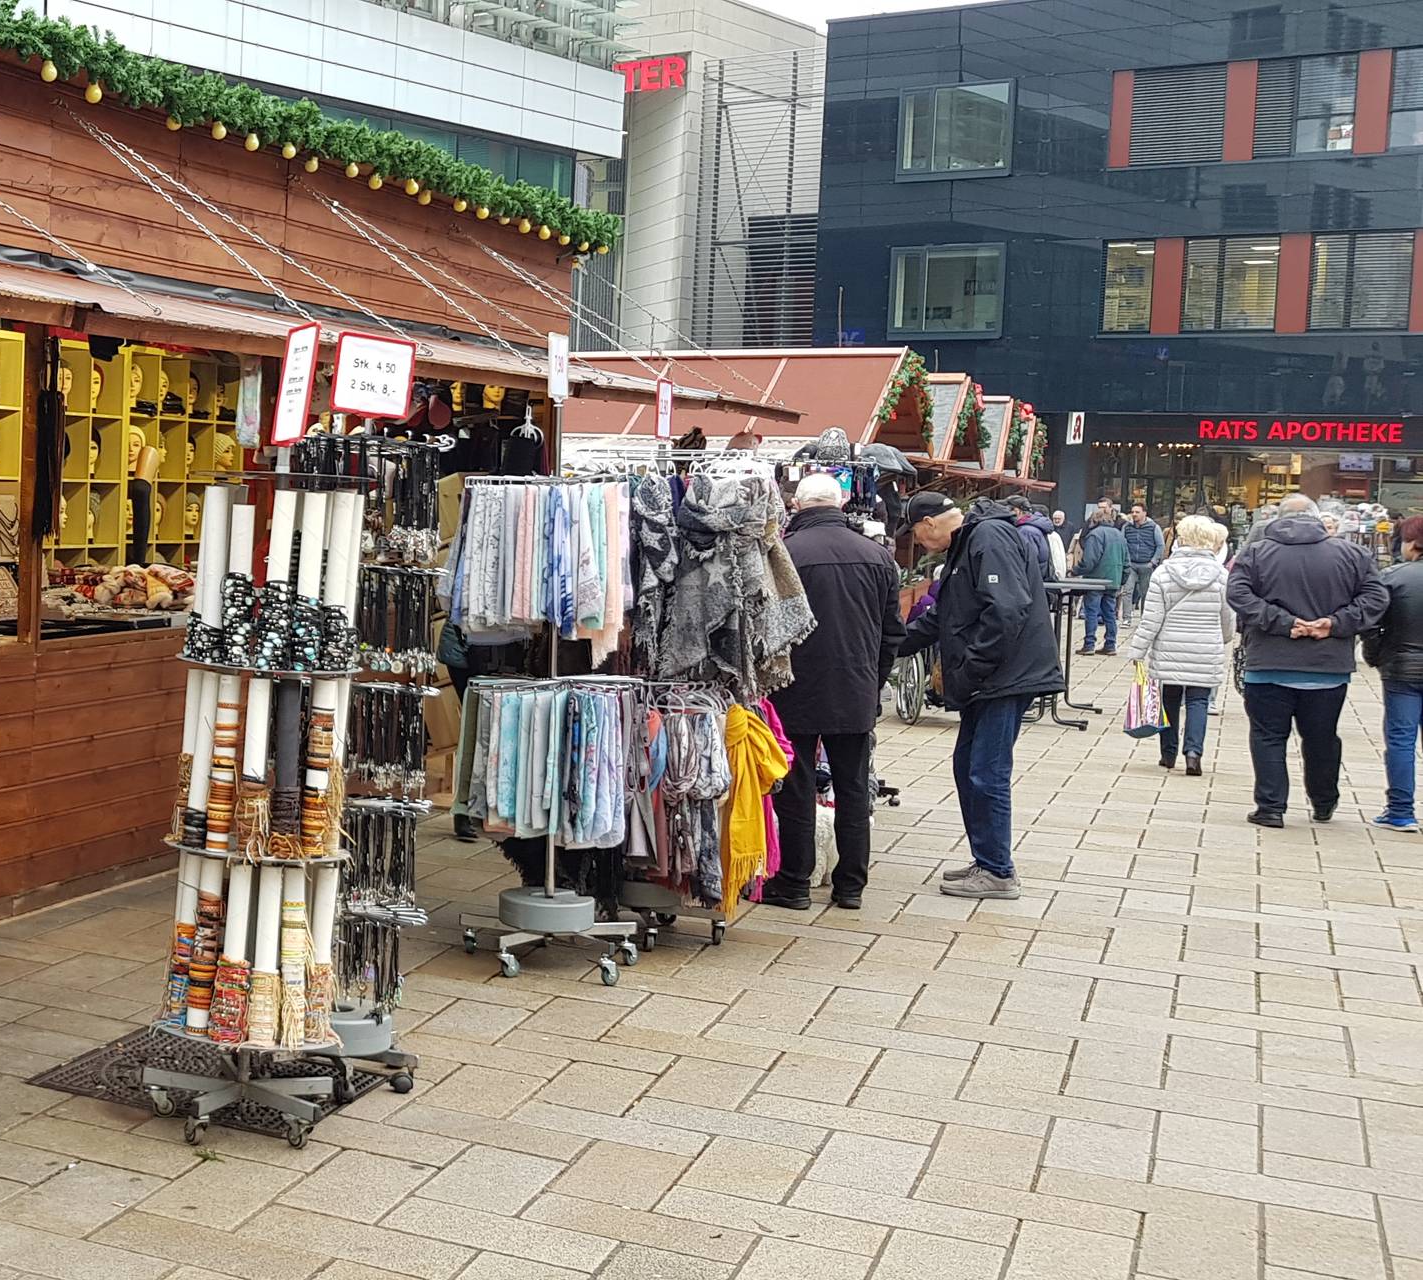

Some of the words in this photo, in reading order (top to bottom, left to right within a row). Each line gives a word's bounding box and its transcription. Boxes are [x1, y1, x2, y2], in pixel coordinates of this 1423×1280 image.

[614, 55, 686, 92] TER
[376, 361, 396, 374] 4,50
[350, 378, 357, 390] 2
[359, 380, 377, 394] Stk.
[381, 383, 397, 397] 8,-
[1199, 419, 1258, 441] RATS
[1267, 420, 1404, 444] APOTHEKE
